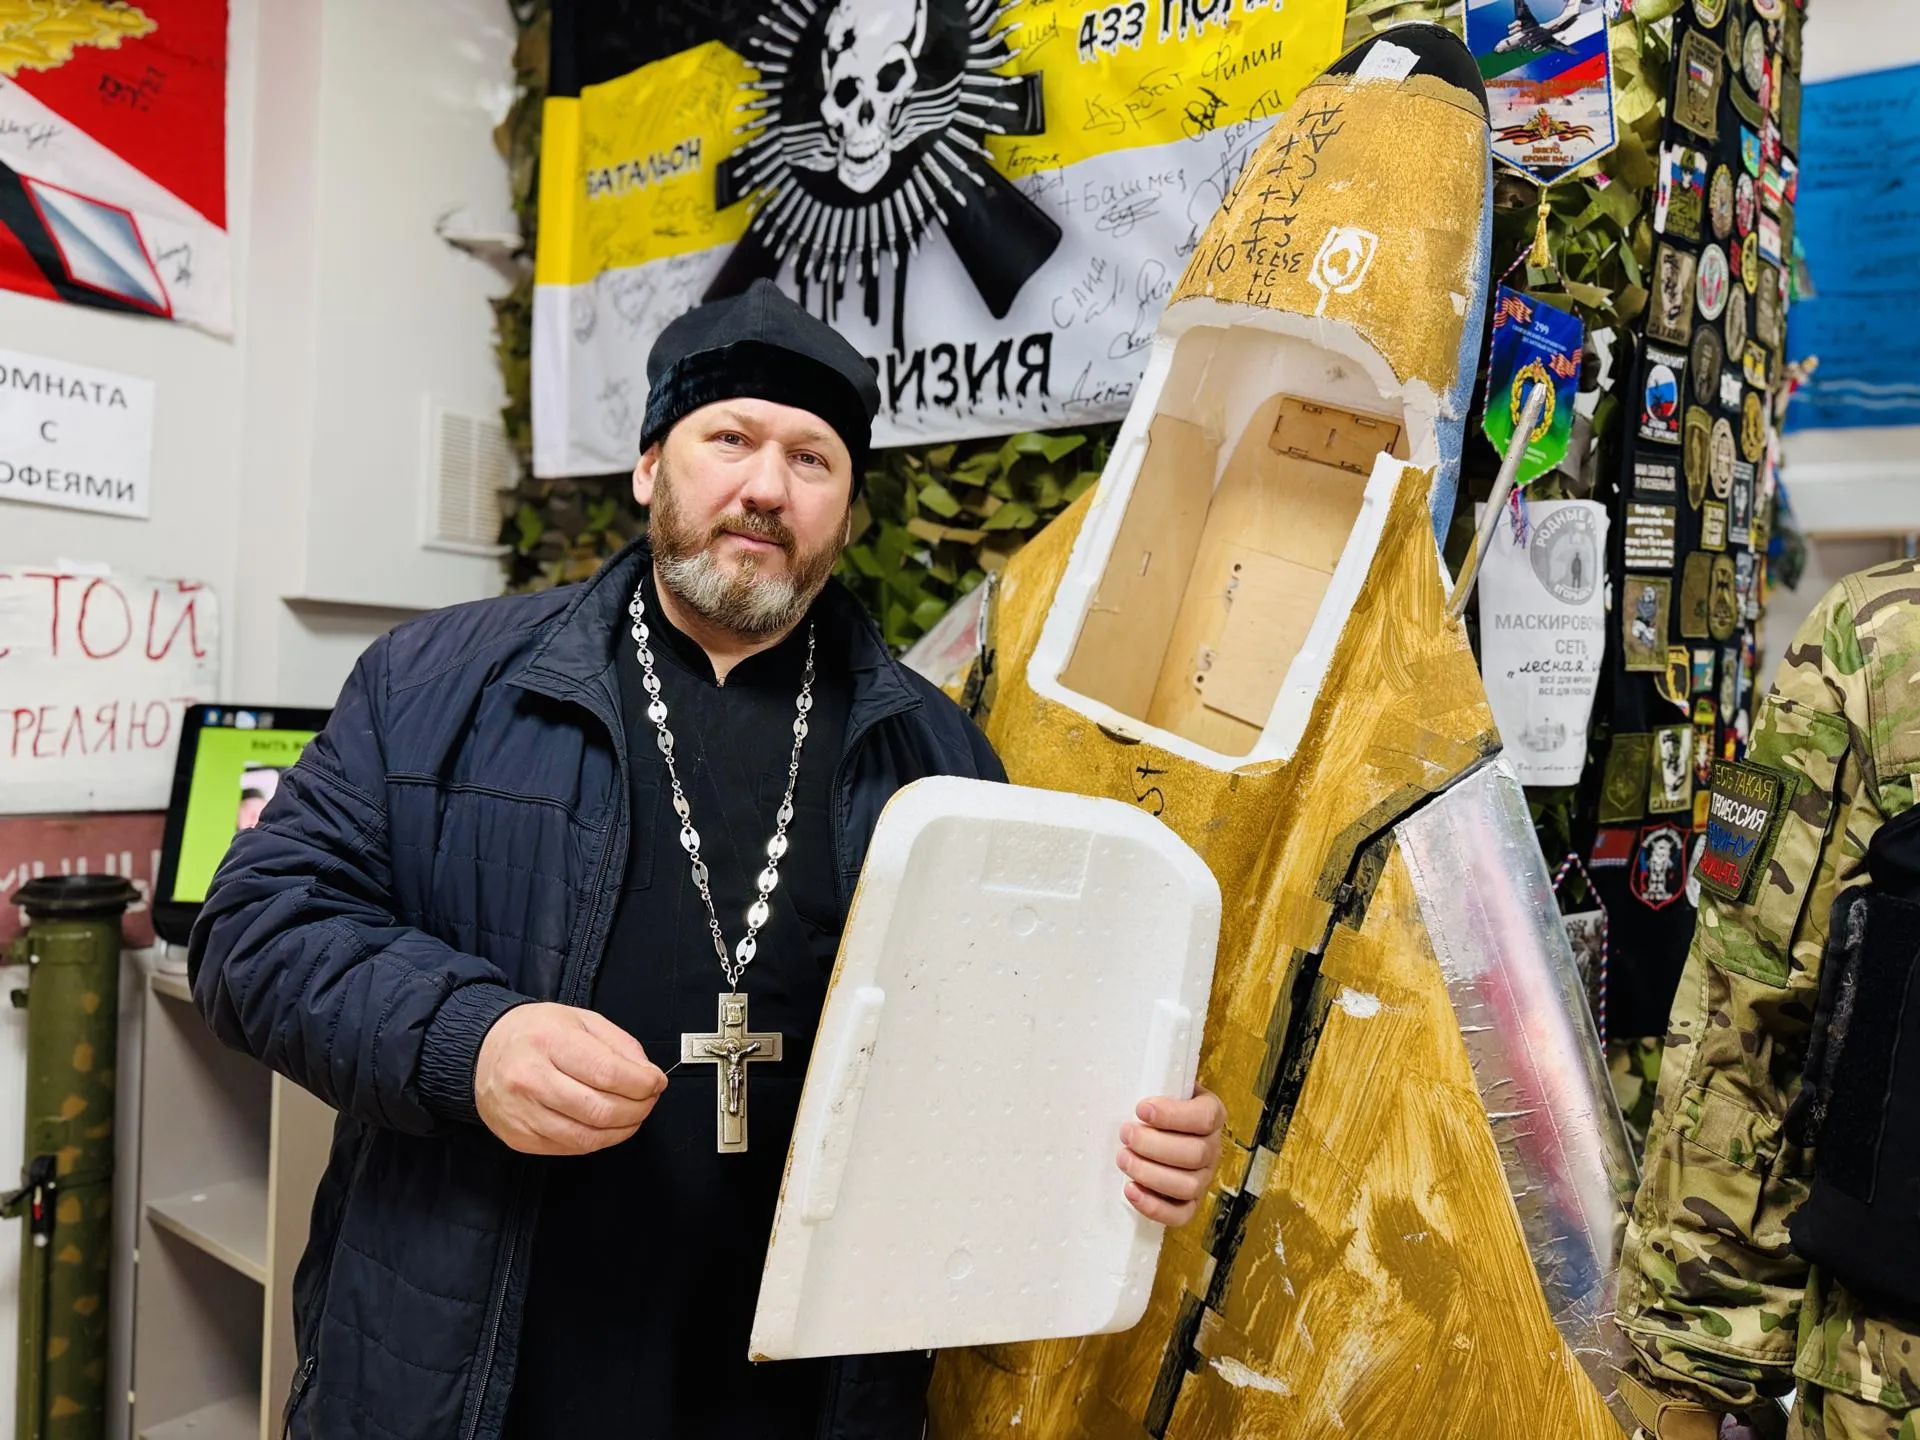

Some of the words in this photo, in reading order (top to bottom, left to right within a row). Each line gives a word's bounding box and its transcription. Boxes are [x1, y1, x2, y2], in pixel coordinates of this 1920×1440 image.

[1078, 2, 1147, 62] 433
[40, 420, 58, 444] С
[1734, 770, 1774, 804] ТАКАЯ
